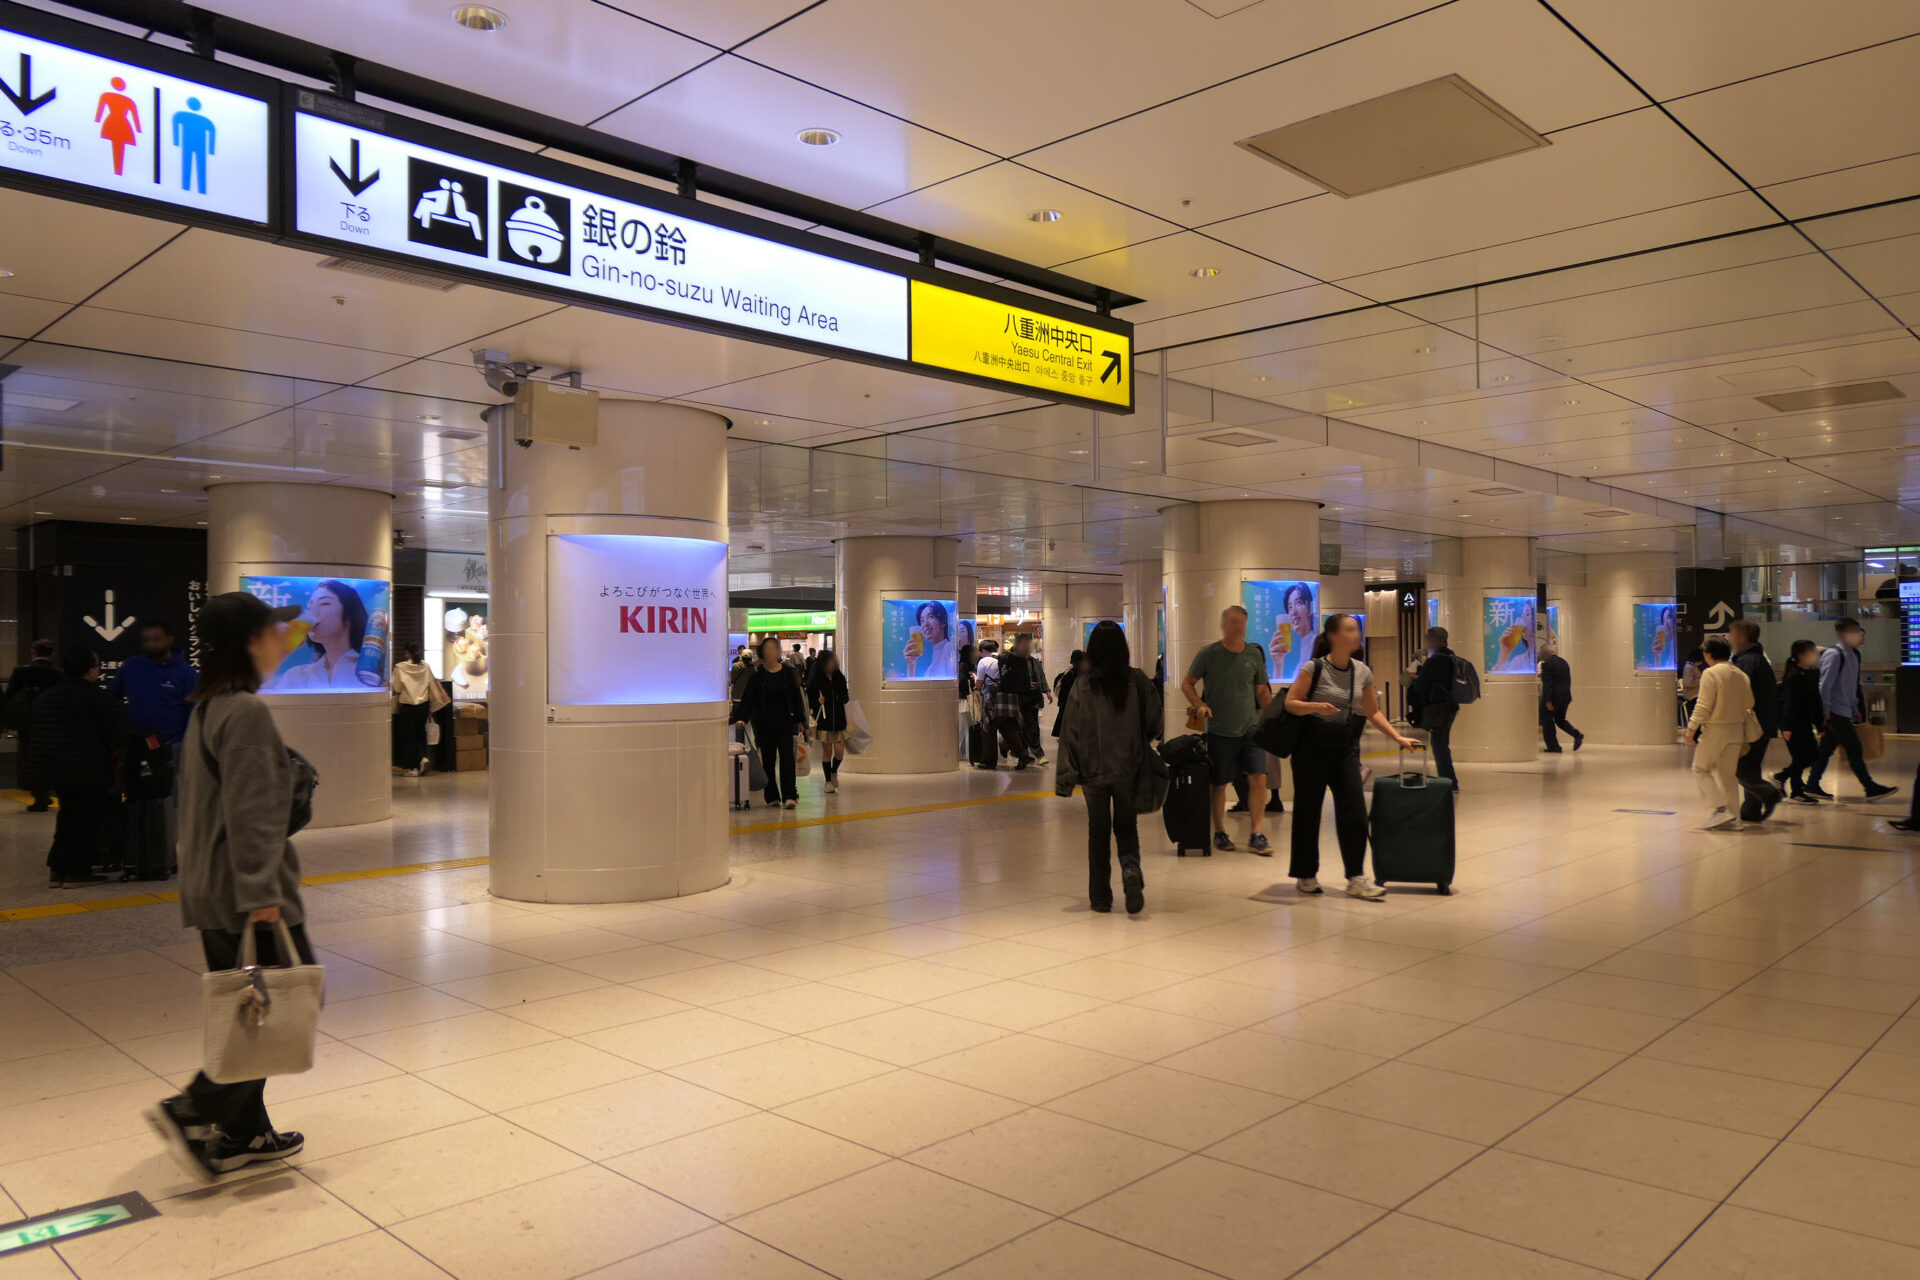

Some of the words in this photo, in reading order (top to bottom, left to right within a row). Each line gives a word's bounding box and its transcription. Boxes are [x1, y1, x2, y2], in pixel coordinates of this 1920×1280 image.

[8, 140, 43, 156] Down
[339, 201, 371, 222] 下る
[340, 220, 370, 236] Down
[582, 203, 688, 267] 銀の鈴
[581, 255, 714, 305] Gin-no-suzu
[720, 286, 792, 326] Waiting
[797, 305, 840, 333] Area
[1003, 312, 1093, 356] 八重洲中央口
[973, 350, 1030, 374] 八重洲中央出口
[1011, 340, 1040, 360] Yaesu
[1042, 348, 1075, 368] Central
[1076, 356, 1093, 373] Exit
[599, 585, 716, 600] よろこびがつなぐ世界へ
[619, 605, 707, 634] KIRIN
[1489, 600, 1516, 627] 新
